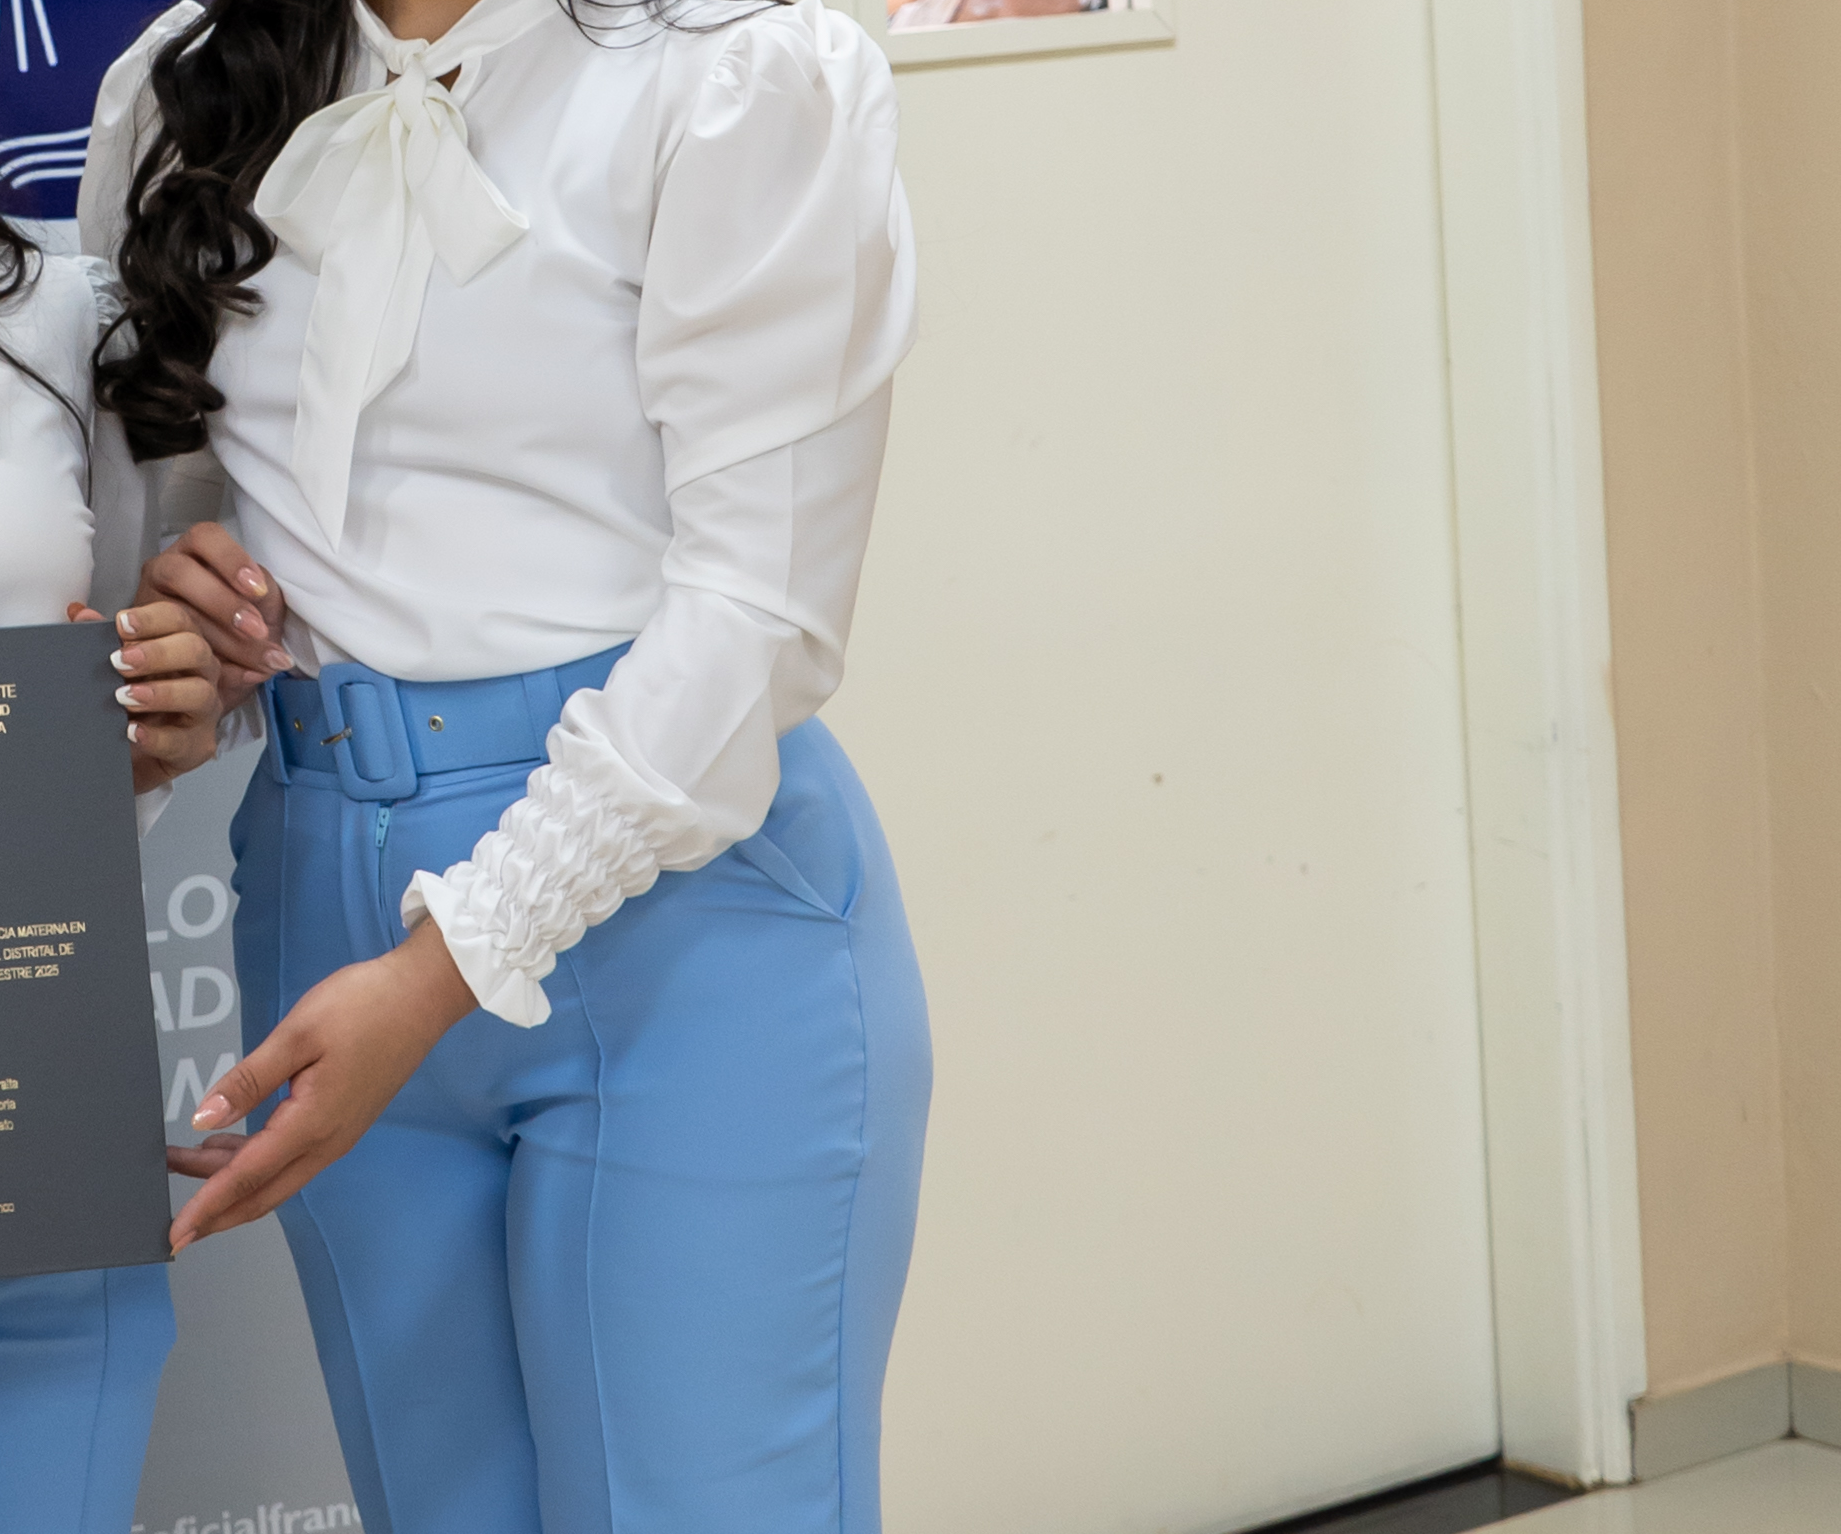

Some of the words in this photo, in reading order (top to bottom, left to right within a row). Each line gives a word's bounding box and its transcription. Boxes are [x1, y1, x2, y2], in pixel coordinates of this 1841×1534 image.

[17, 923, 69, 938] MATERNA
[70, 921, 86, 934] EN
[3, 945, 58, 961] DISTRITAL
[59, 942, 75, 956] DE
[34, 964, 59, 979] 2025
